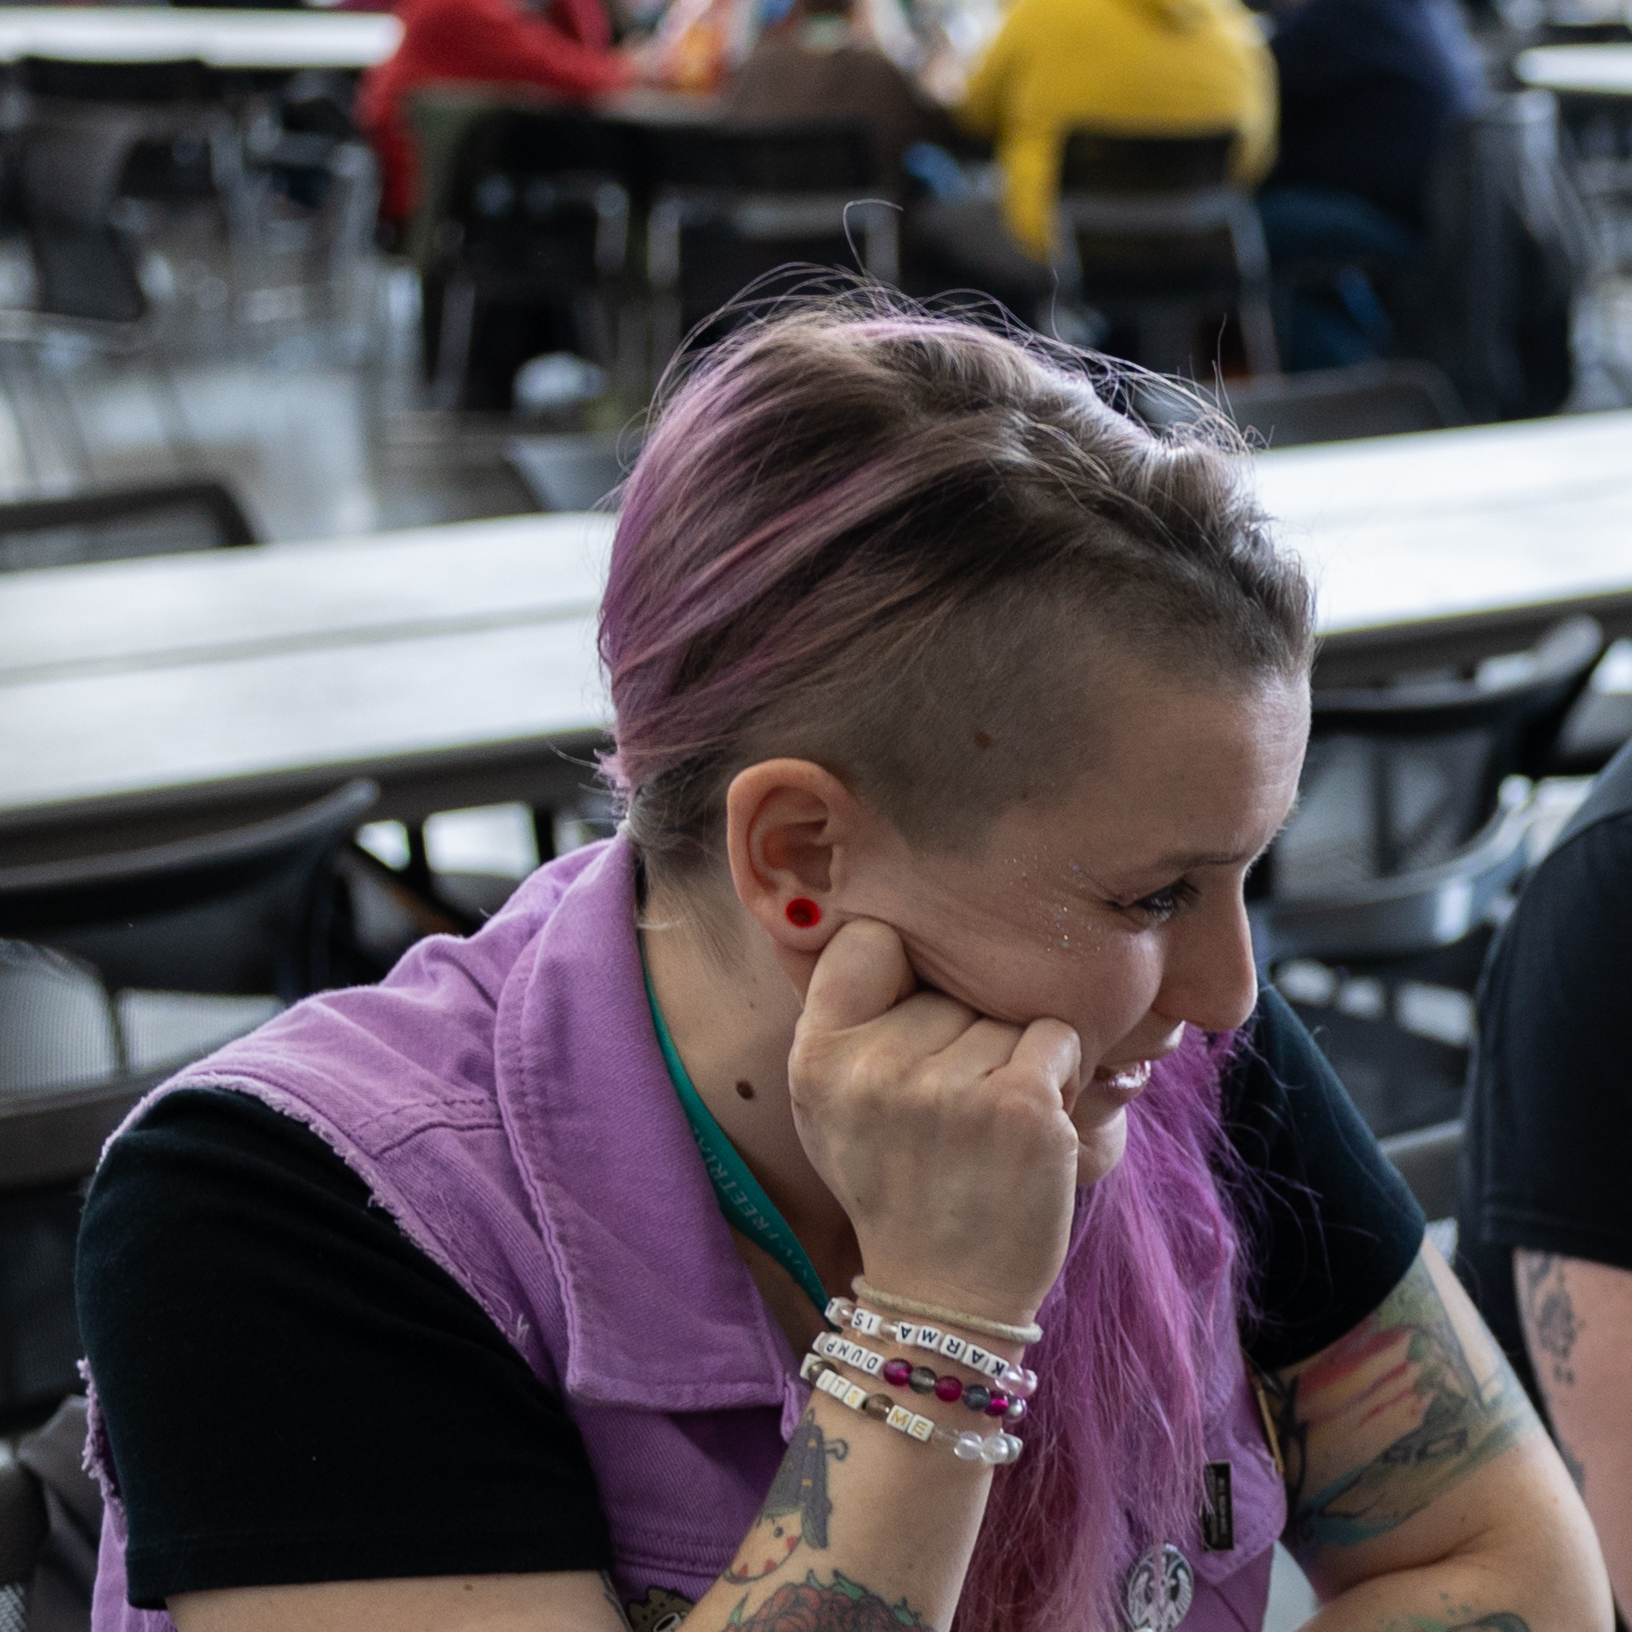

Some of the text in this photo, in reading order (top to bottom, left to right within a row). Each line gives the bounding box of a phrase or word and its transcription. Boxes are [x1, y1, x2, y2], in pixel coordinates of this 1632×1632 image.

[853, 1311, 875, 1329] IS
[826, 1340, 880, 1371] DUMP
[899, 1325, 1007, 1377] KARMA
[821, 1373, 930, 1438] ITS ME
